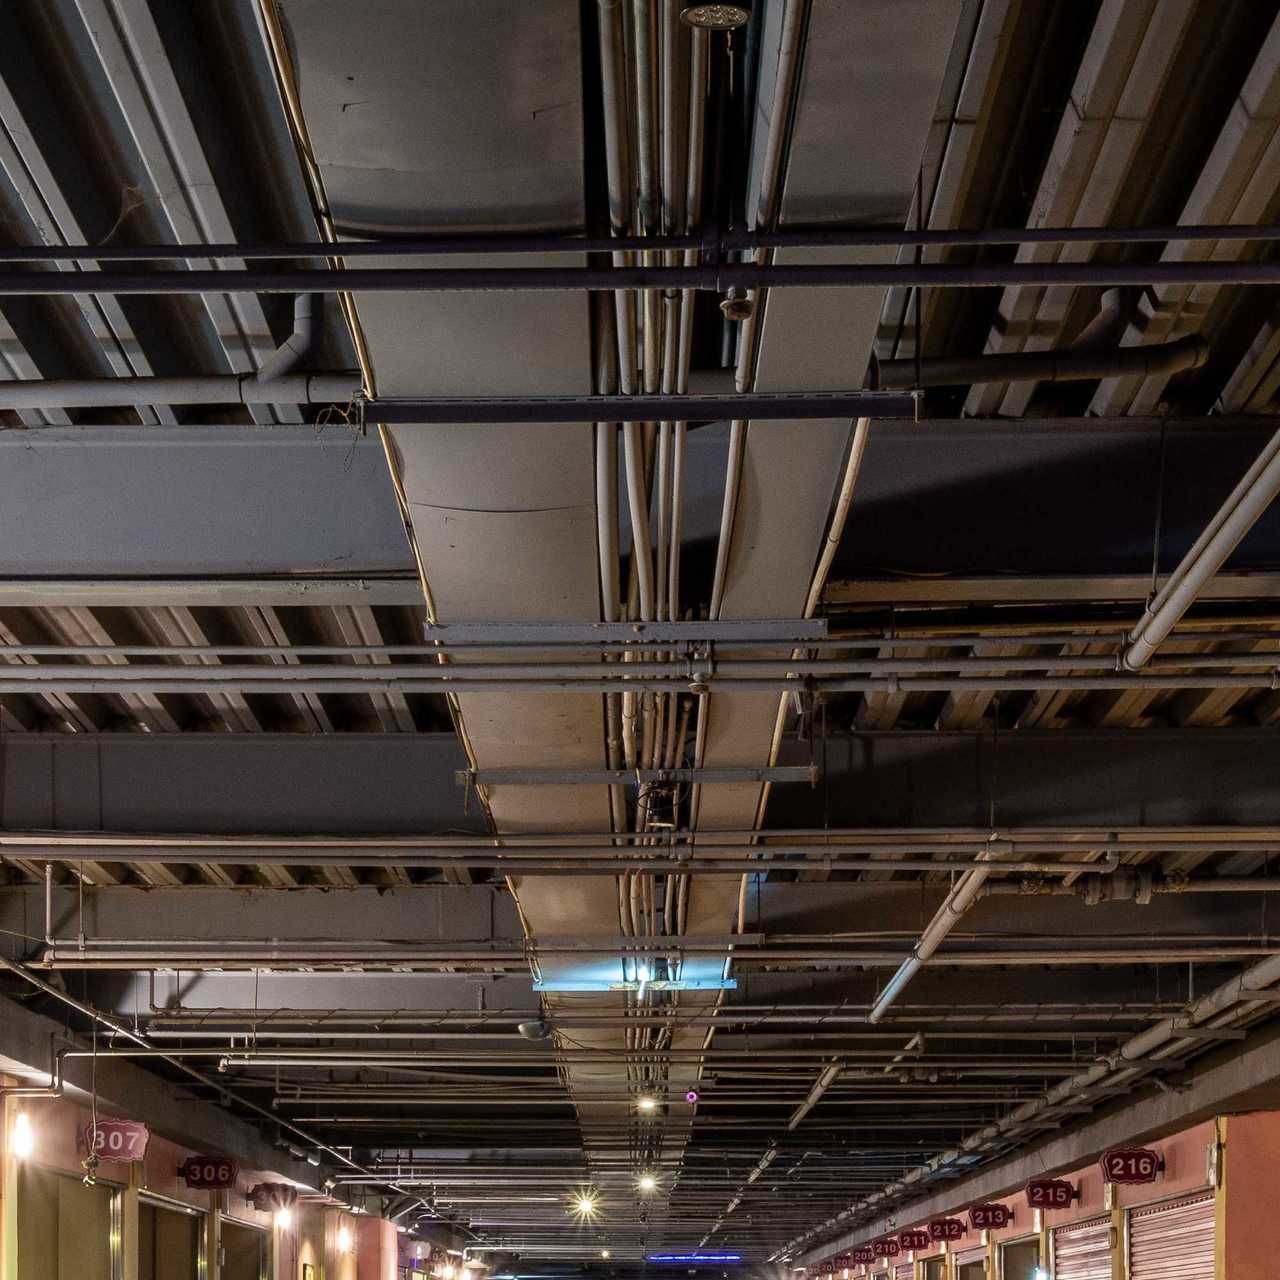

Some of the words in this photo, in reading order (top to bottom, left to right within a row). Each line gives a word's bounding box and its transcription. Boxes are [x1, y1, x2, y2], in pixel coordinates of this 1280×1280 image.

[95, 1131, 139, 1150] 307
[190, 1165, 230, 1181] 306
[1111, 1157, 1152, 1175] 216
[1032, 1187, 1067, 1202] 215
[975, 1209, 1004, 1224] 213
[933, 1224, 959, 1236] 212
[875, 1243, 897, 1254] 210
[903, 1236, 925, 1246] 211
